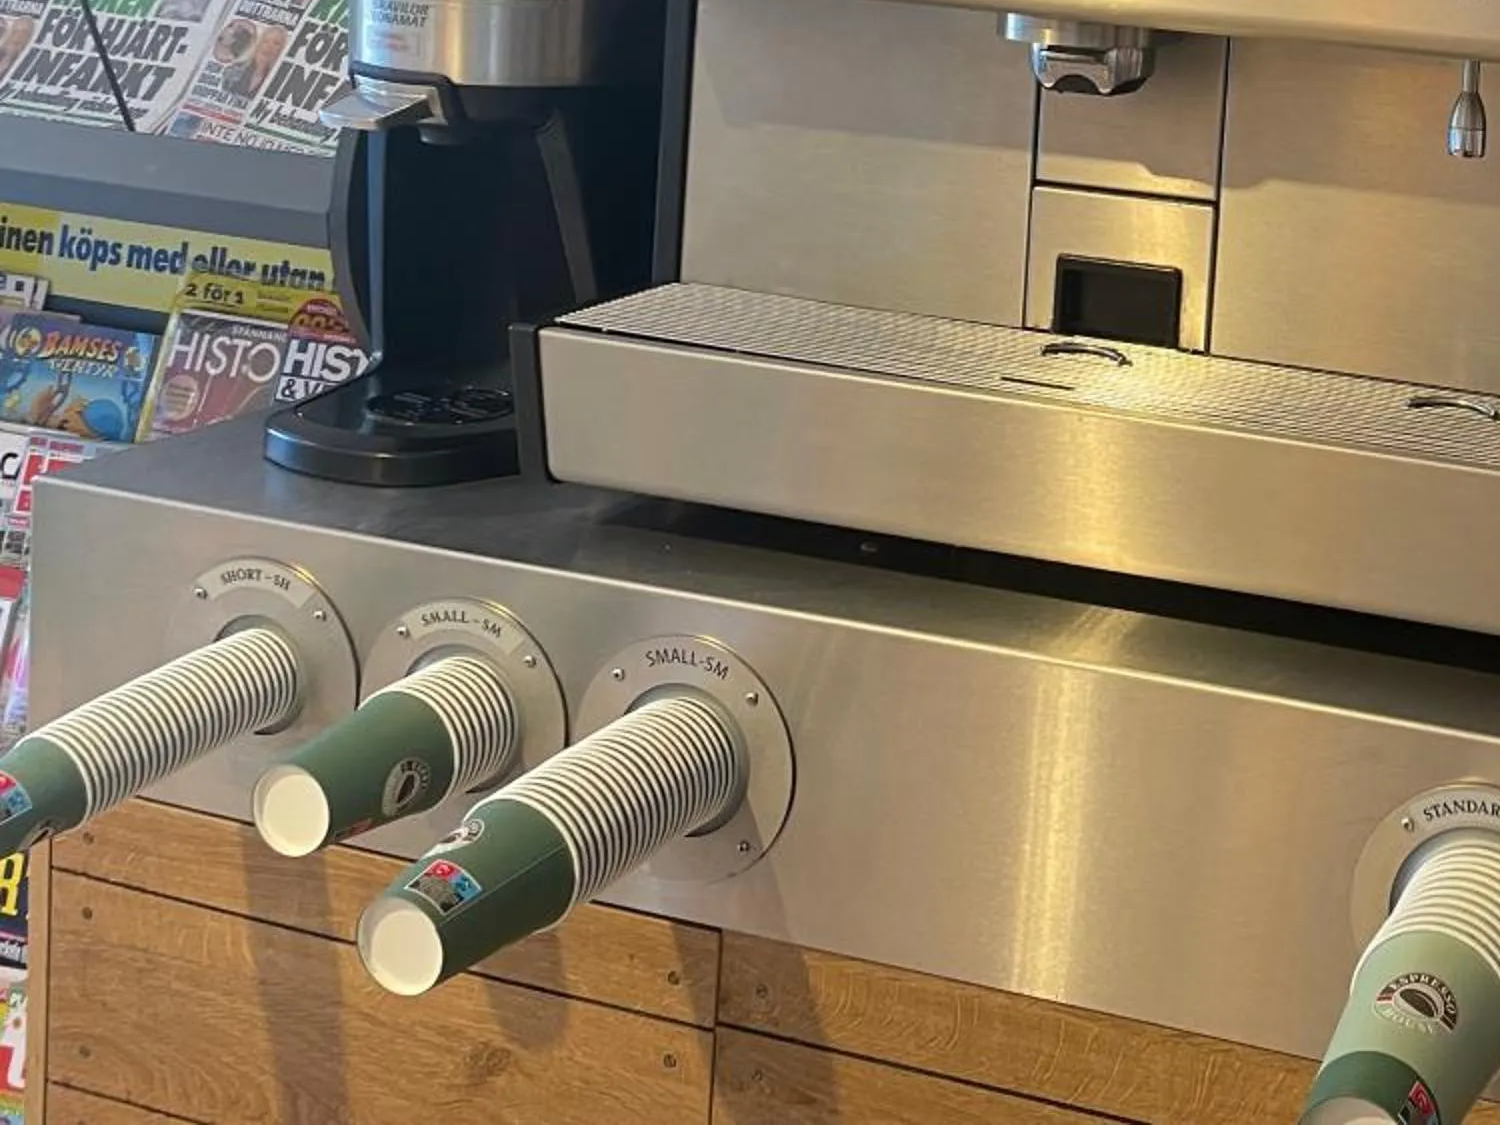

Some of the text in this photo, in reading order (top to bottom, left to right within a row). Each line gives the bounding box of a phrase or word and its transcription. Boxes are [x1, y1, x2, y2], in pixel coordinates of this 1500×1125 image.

[58, 224, 122, 270] köps
[127, 241, 190, 276] med
[191, 246, 256, 278] eller
[185, 283, 198, 297] 2
[203, 282, 229, 301] för
[42, 331, 123, 362] BAMSES
[167, 329, 281, 383] HISTO
[220, 569, 290, 591] SHORT SH
[421, 612, 503, 638] SMALL SM
